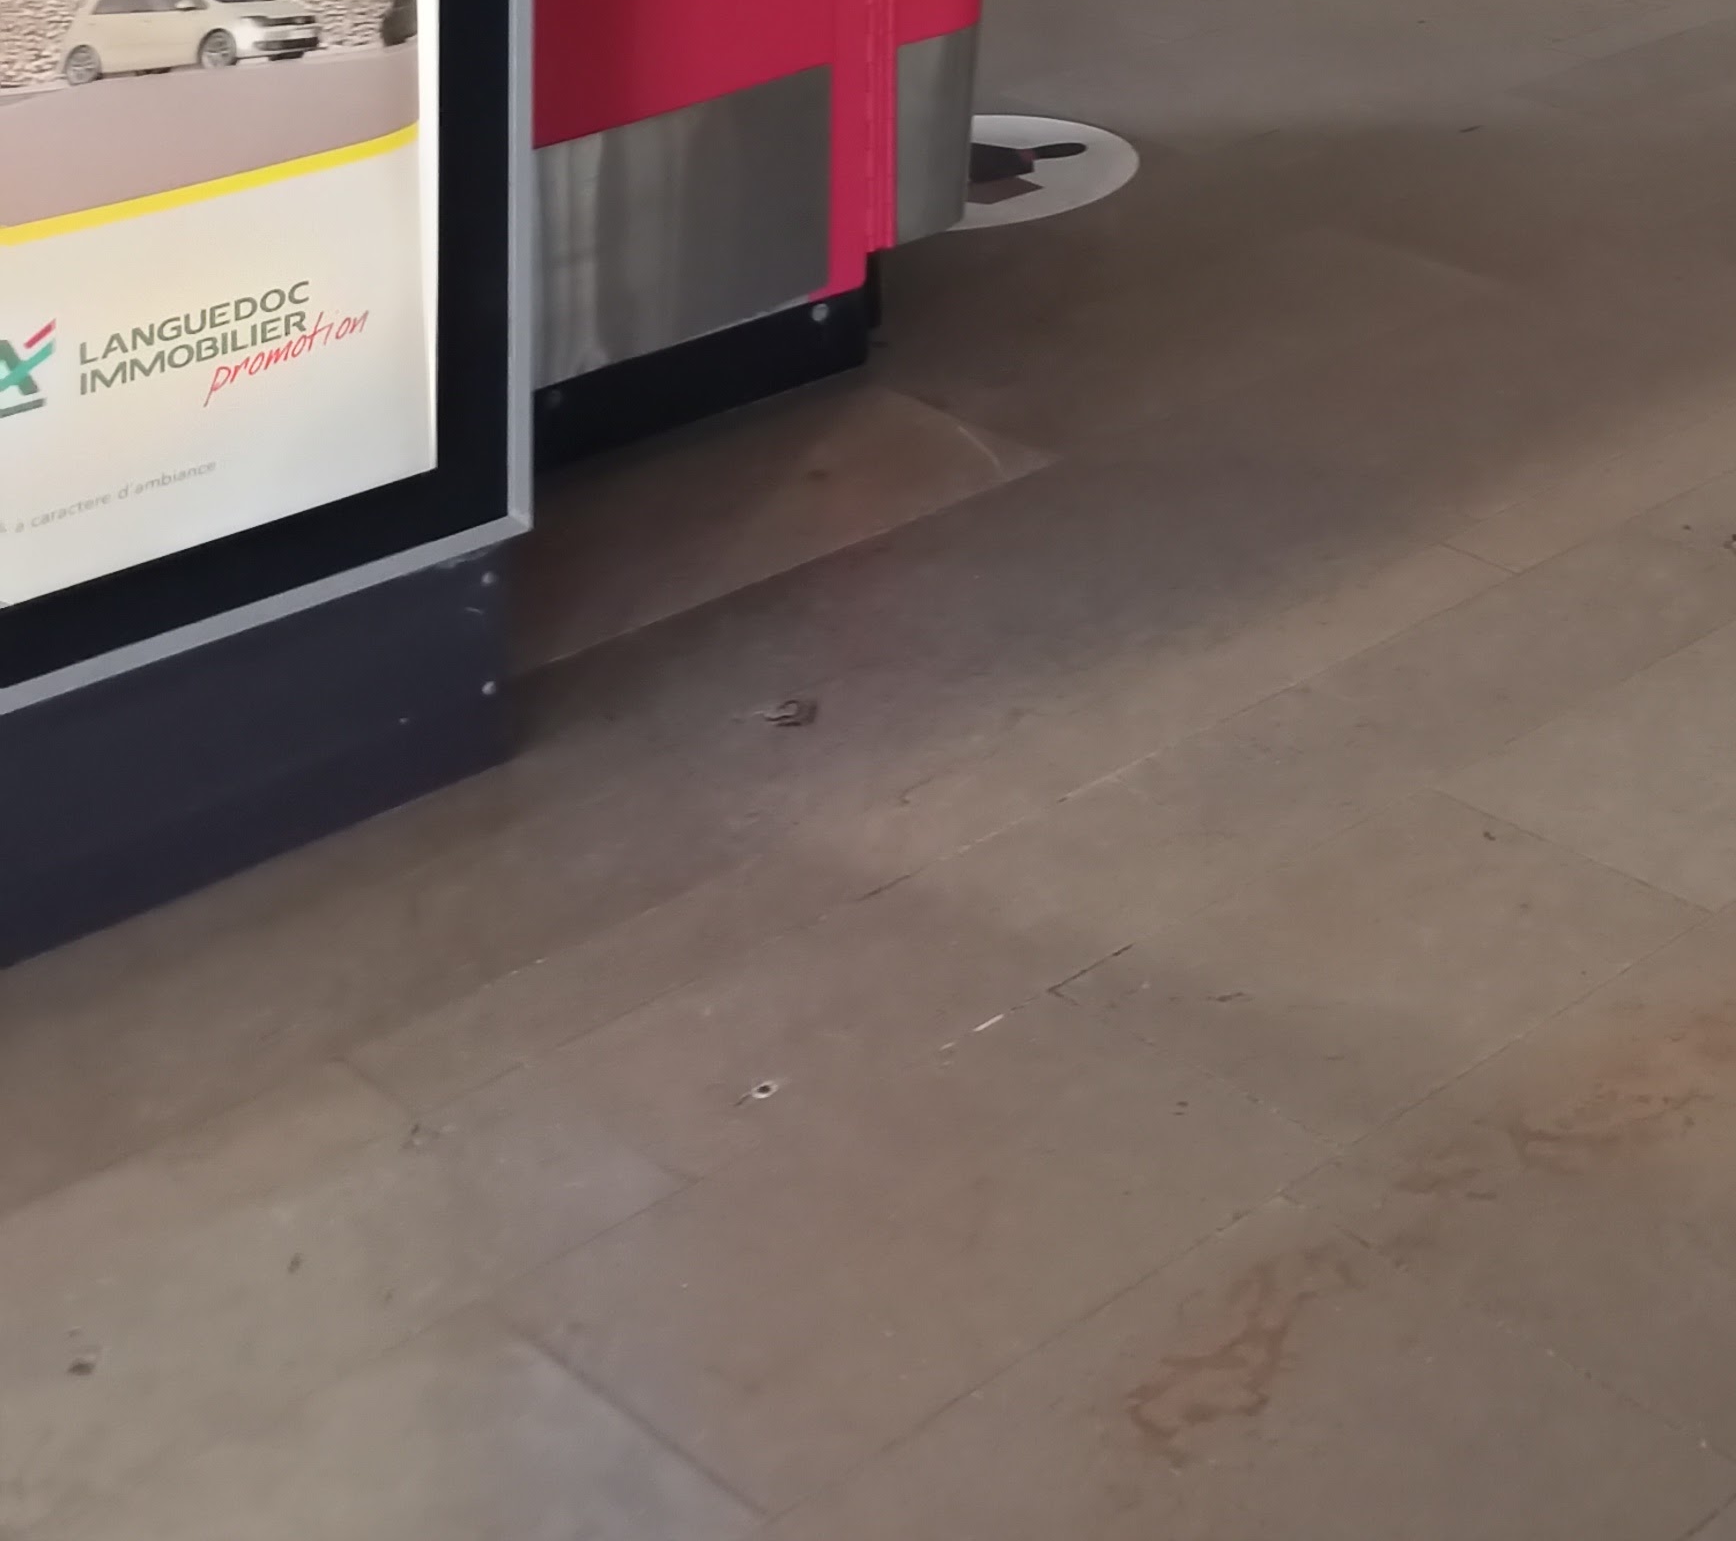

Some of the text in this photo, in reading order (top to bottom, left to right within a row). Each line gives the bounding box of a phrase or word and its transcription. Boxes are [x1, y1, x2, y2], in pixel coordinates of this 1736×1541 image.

[79, 280, 309, 365] LANGUEDOC
[79, 310, 307, 396] IMMOBILIER
[202, 308, 370, 408] promotion
[117, 461, 217, 500] d'ambiance
